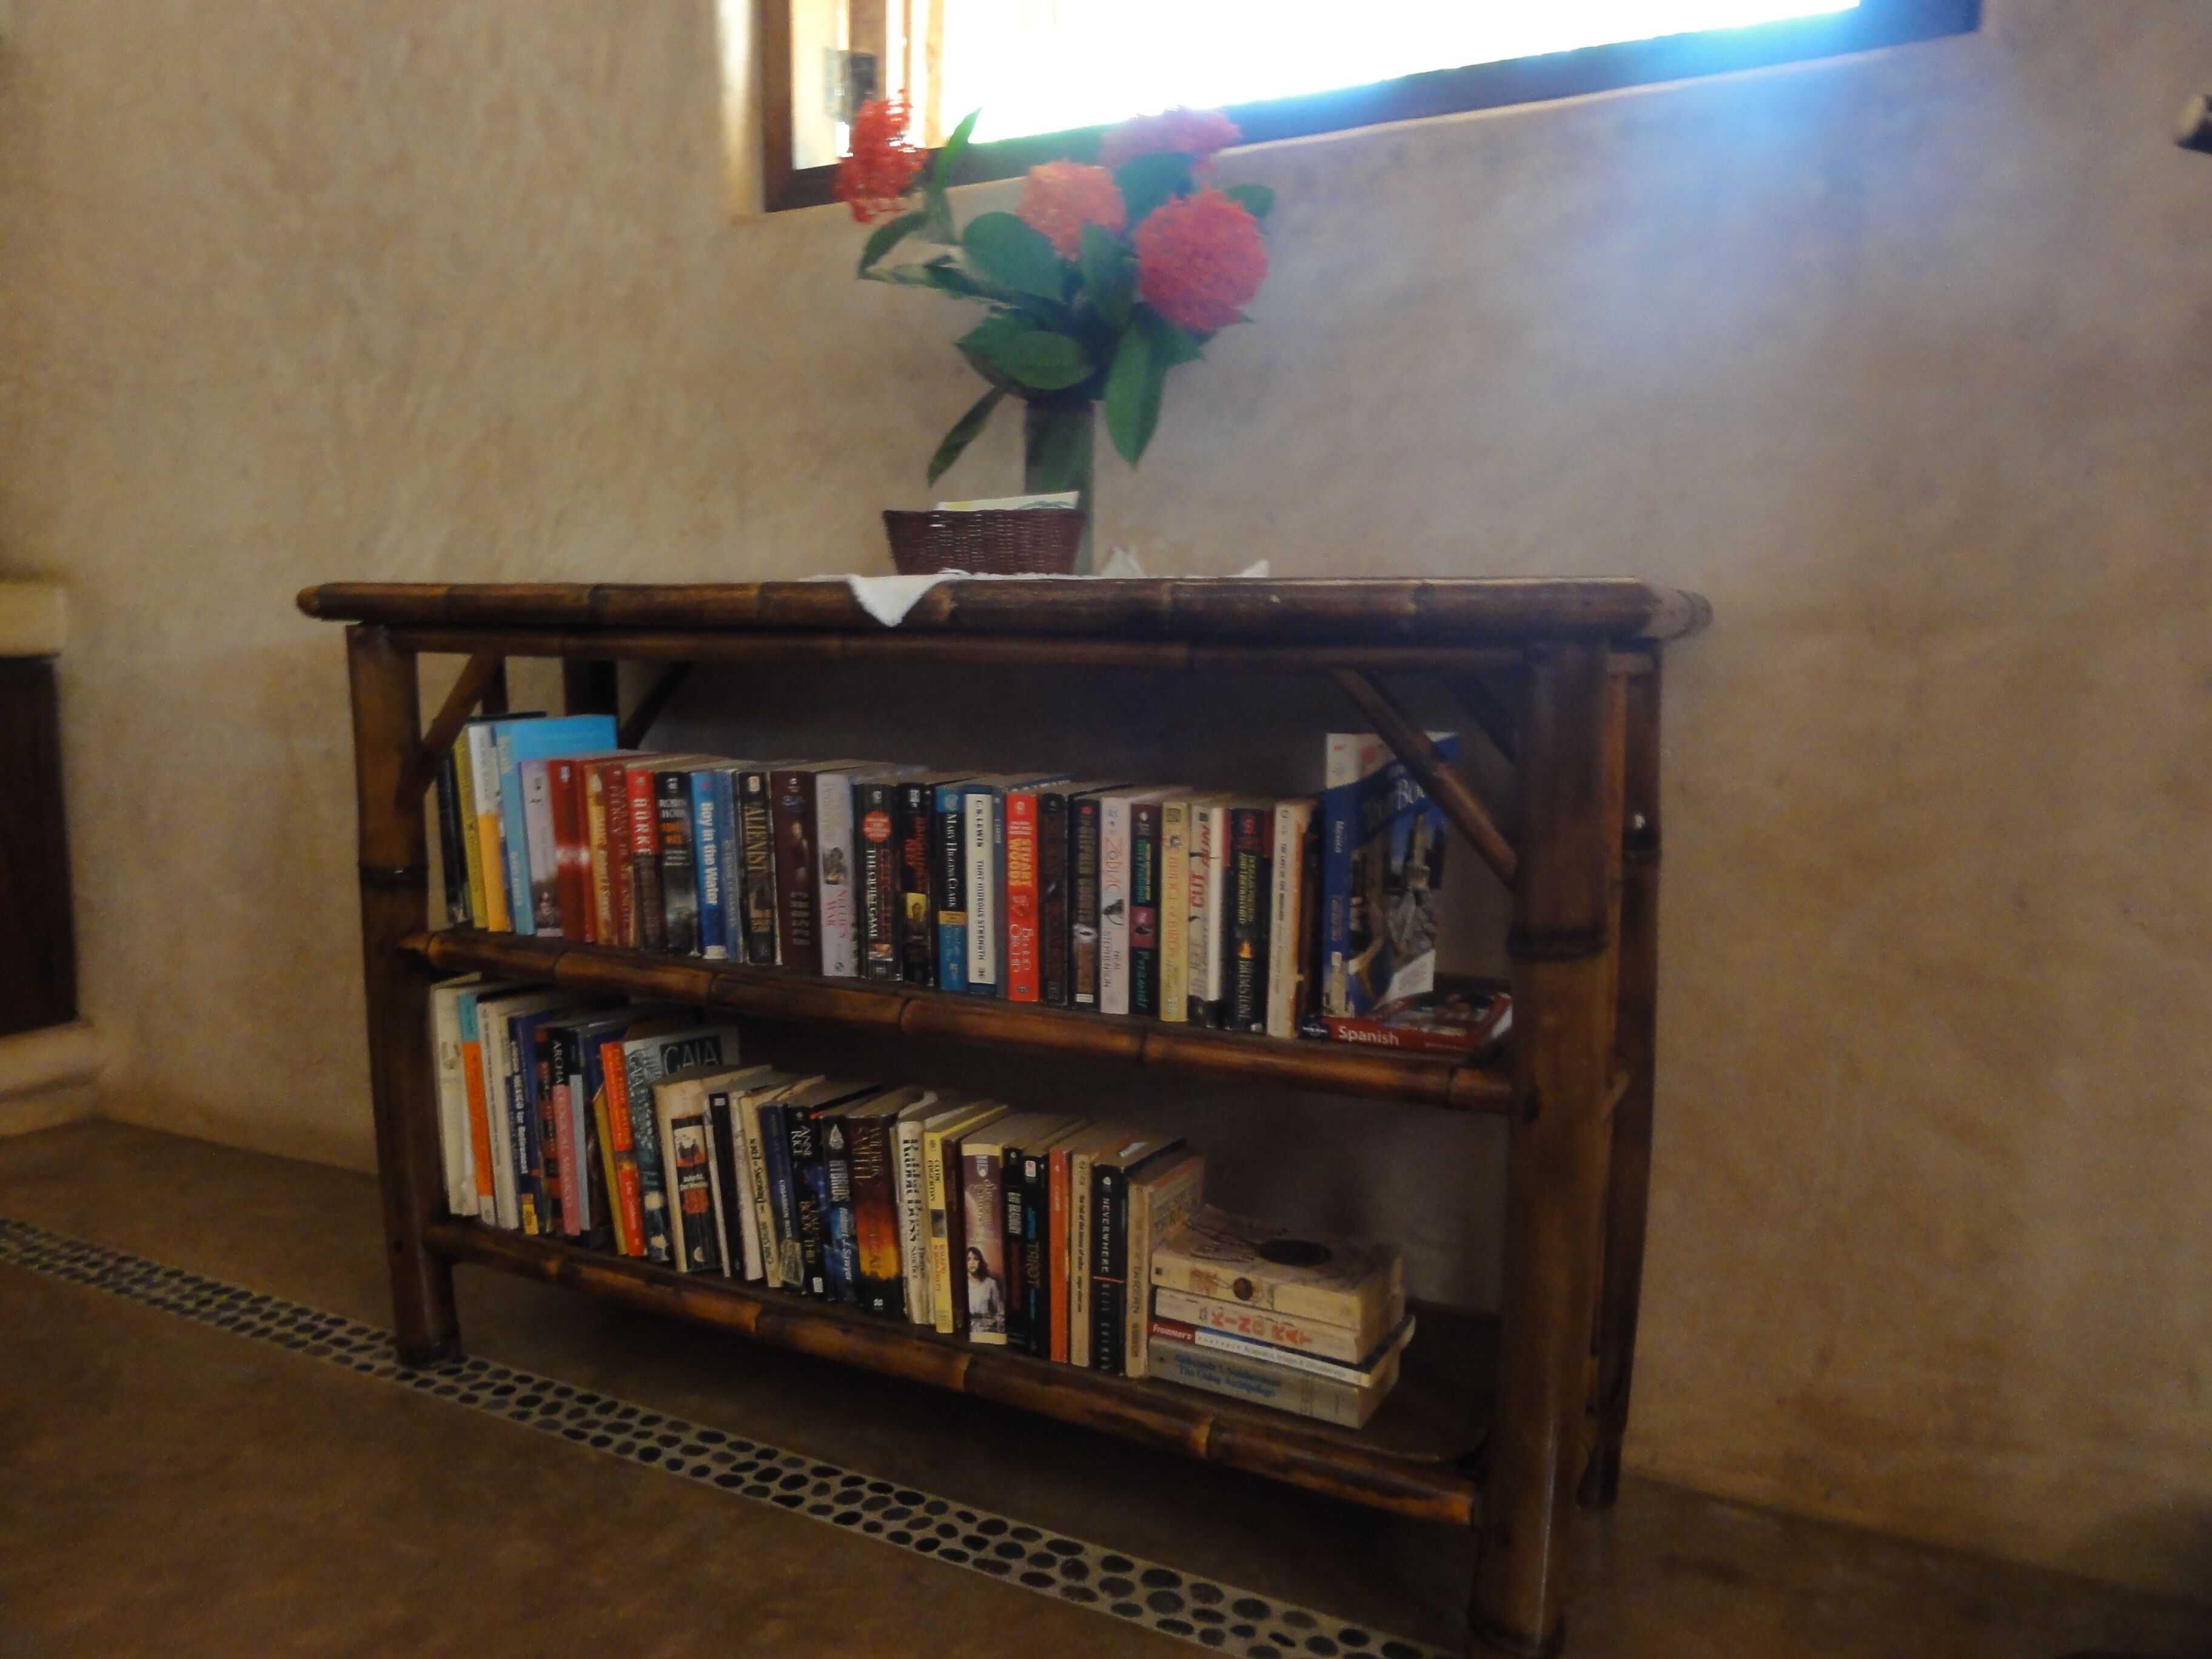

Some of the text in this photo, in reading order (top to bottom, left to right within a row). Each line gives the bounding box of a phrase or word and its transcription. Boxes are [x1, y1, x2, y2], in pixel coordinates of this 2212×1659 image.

[698, 803, 719, 905] Boy in the Water
[743, 807, 768, 871] ALIENIST
[976, 817, 985, 848] LEWIS
[945, 813, 959, 908] MARY HIGGINS CLARK
[1008, 839, 1021, 886] WOODS
[1021, 839, 1032, 887] STUART
[1104, 837, 1124, 894] ZODIAC
[826, 900, 837, 927] WAR
[976, 860, 986, 960] THAT HIDEOUS STRENGTH
[1190, 873, 1205, 908] CUT
[1010, 923, 1023, 973] ORCHID
[1102, 931, 1112, 988] STEPHENSON
[1112, 951, 1122, 970] NEAL
[1136, 950, 1152, 1009] Pyramids
[1237, 960, 1251, 1021] BRIMSTONE
[1338, 1025, 1400, 1047] Spanish
[790, 1130, 802, 1156] RICE
[800, 1125, 813, 1157] ANNE
[828, 1159, 850, 1202] HYBRIDS
[903, 1139, 920, 1194] Rabbit
[799, 1201, 813, 1233] BODY
[839, 1207, 850, 1238] Robert
[907, 1199, 923, 1242] Boss
[1099, 1197, 1111, 1273] NEVERWHERE
[842, 1248, 853, 1282] Sawyer
[1026, 1242, 1041, 1289] TAROT
[1153, 1324, 1193, 1341] Frommer's
